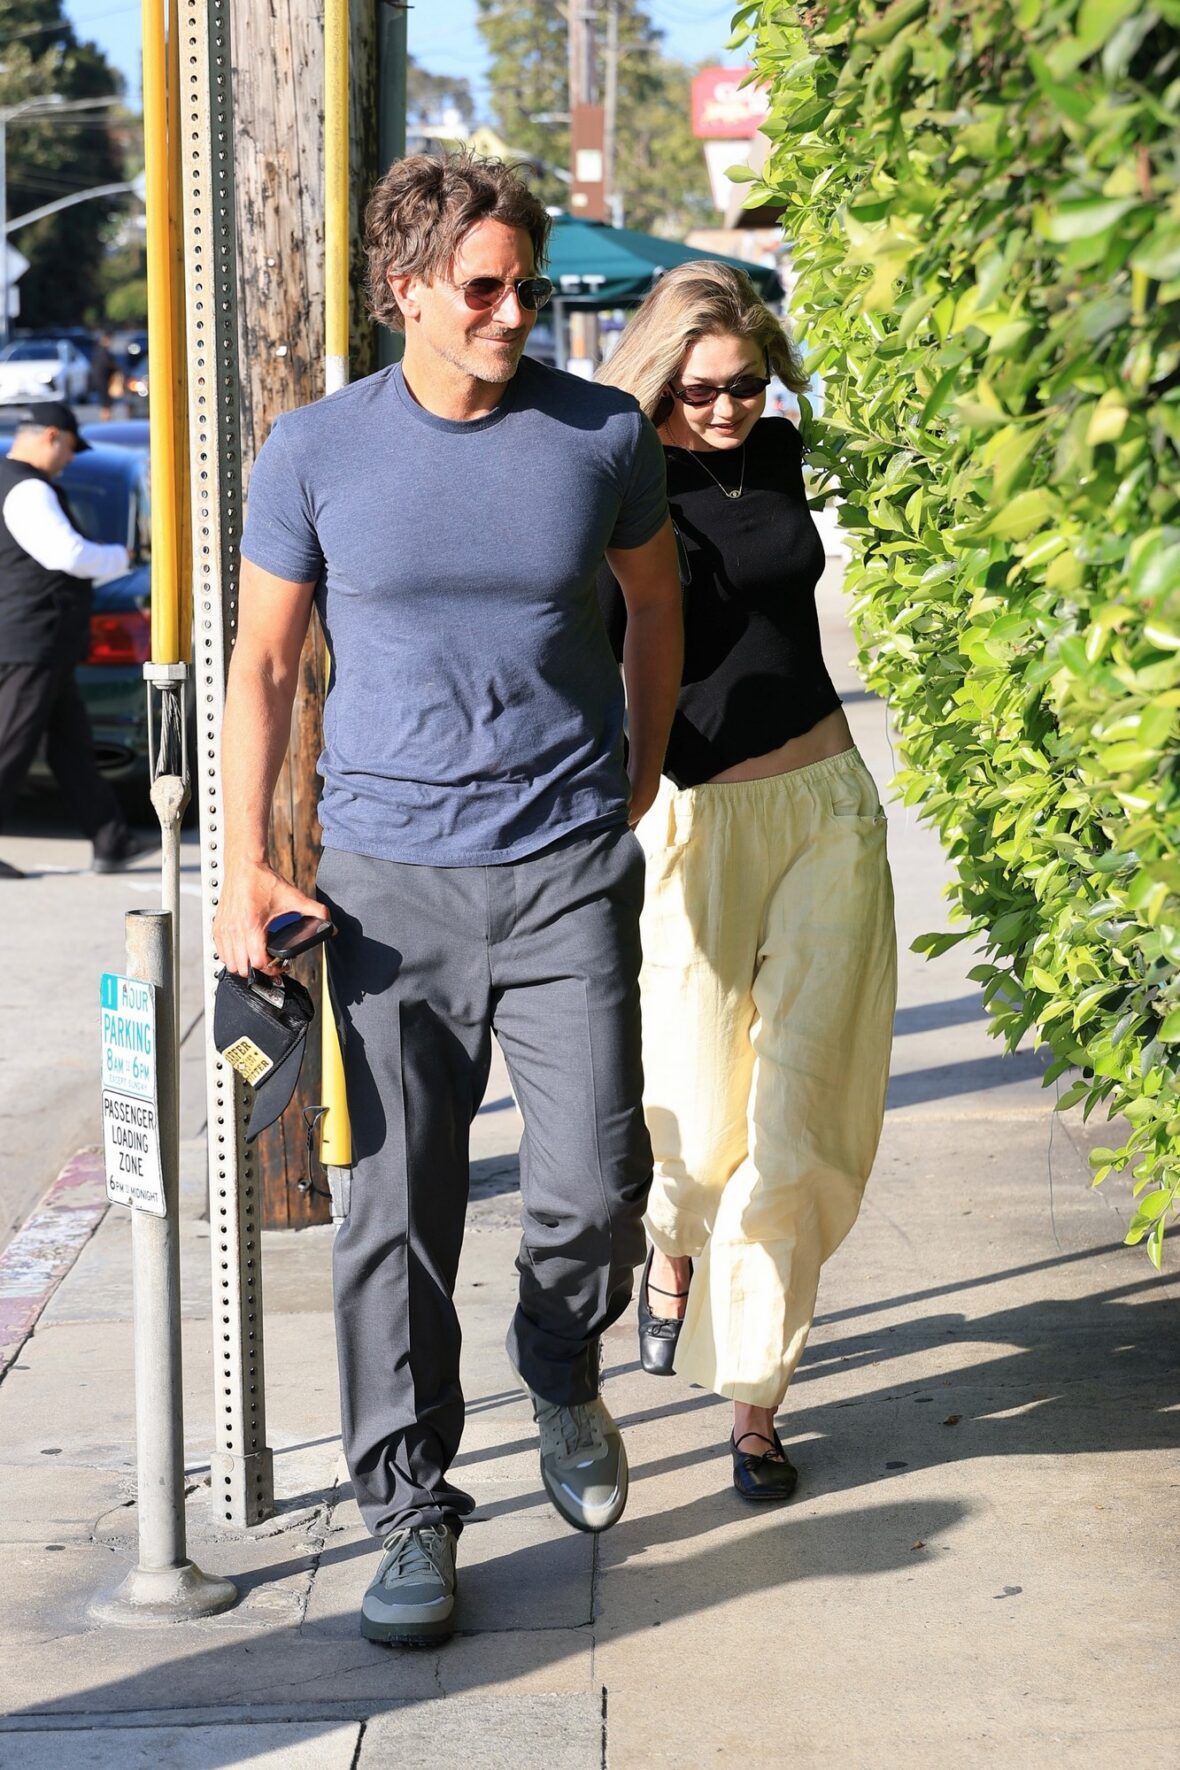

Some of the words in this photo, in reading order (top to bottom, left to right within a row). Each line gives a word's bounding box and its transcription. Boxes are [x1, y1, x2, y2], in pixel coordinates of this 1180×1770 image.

[107, 978, 112, 1005] 1
[122, 986, 148, 1012] HOUR
[104, 1013, 151, 1055] PARKING
[104, 1098, 154, 1130] PASSENGER
[112, 1124, 148, 1153] LOADING
[119, 1151, 144, 1177] ZONE
[131, 1186, 159, 1203] MIDNIGHT
